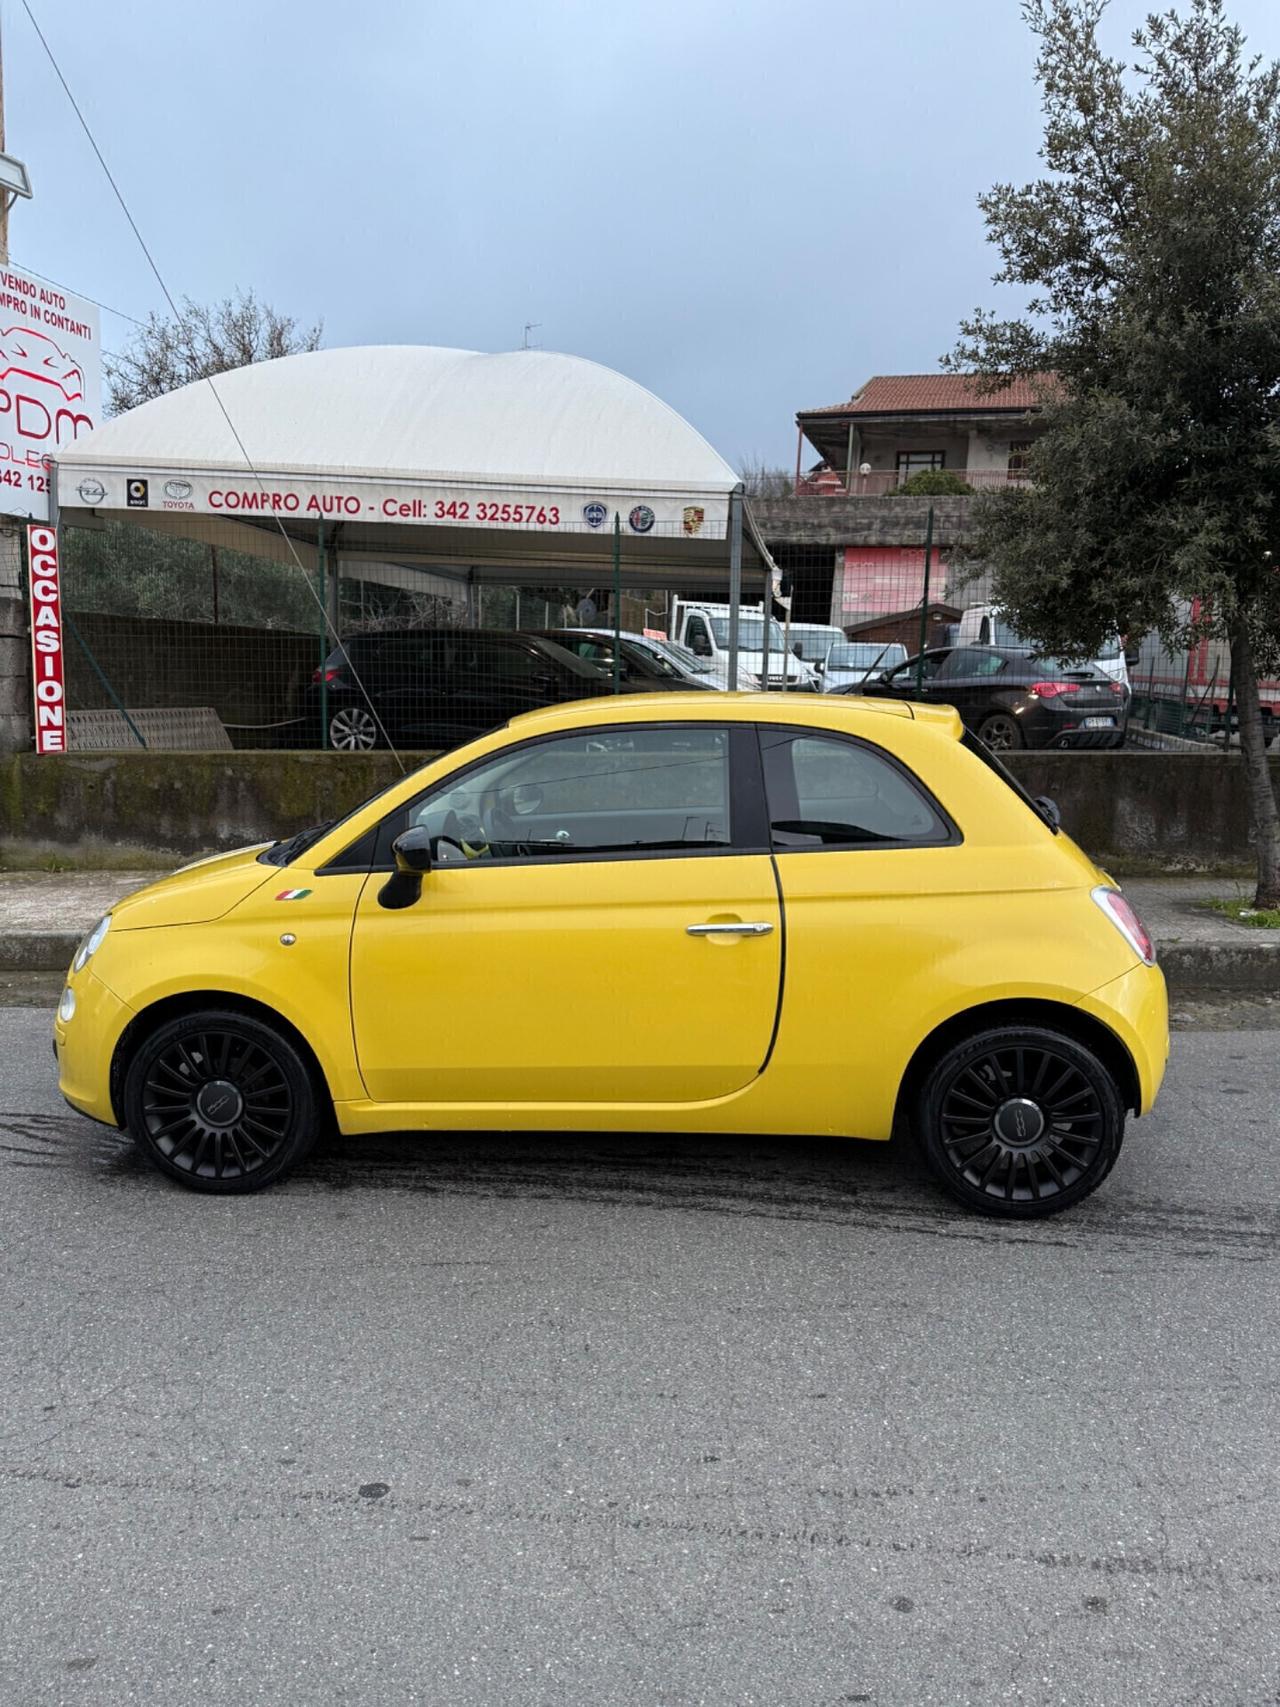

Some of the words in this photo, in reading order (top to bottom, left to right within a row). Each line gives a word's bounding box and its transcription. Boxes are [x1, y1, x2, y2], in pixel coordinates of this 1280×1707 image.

[0, 271, 37, 298] VENDO
[40, 288, 66, 310] AUTO
[30, 303, 41, 320] IN
[43, 310, 92, 340] CONTANTI
[0, 469, 23, 488] 42
[163, 500, 195, 510] TOYOTA
[208, 490, 300, 511] COMPRO
[306, 494, 361, 514] AUTO
[382, 498, 427, 518] Cell:
[434, 500, 470, 520] 342
[475, 502, 560, 525] 3255763
[31, 528, 63, 751] OCCASIONE
